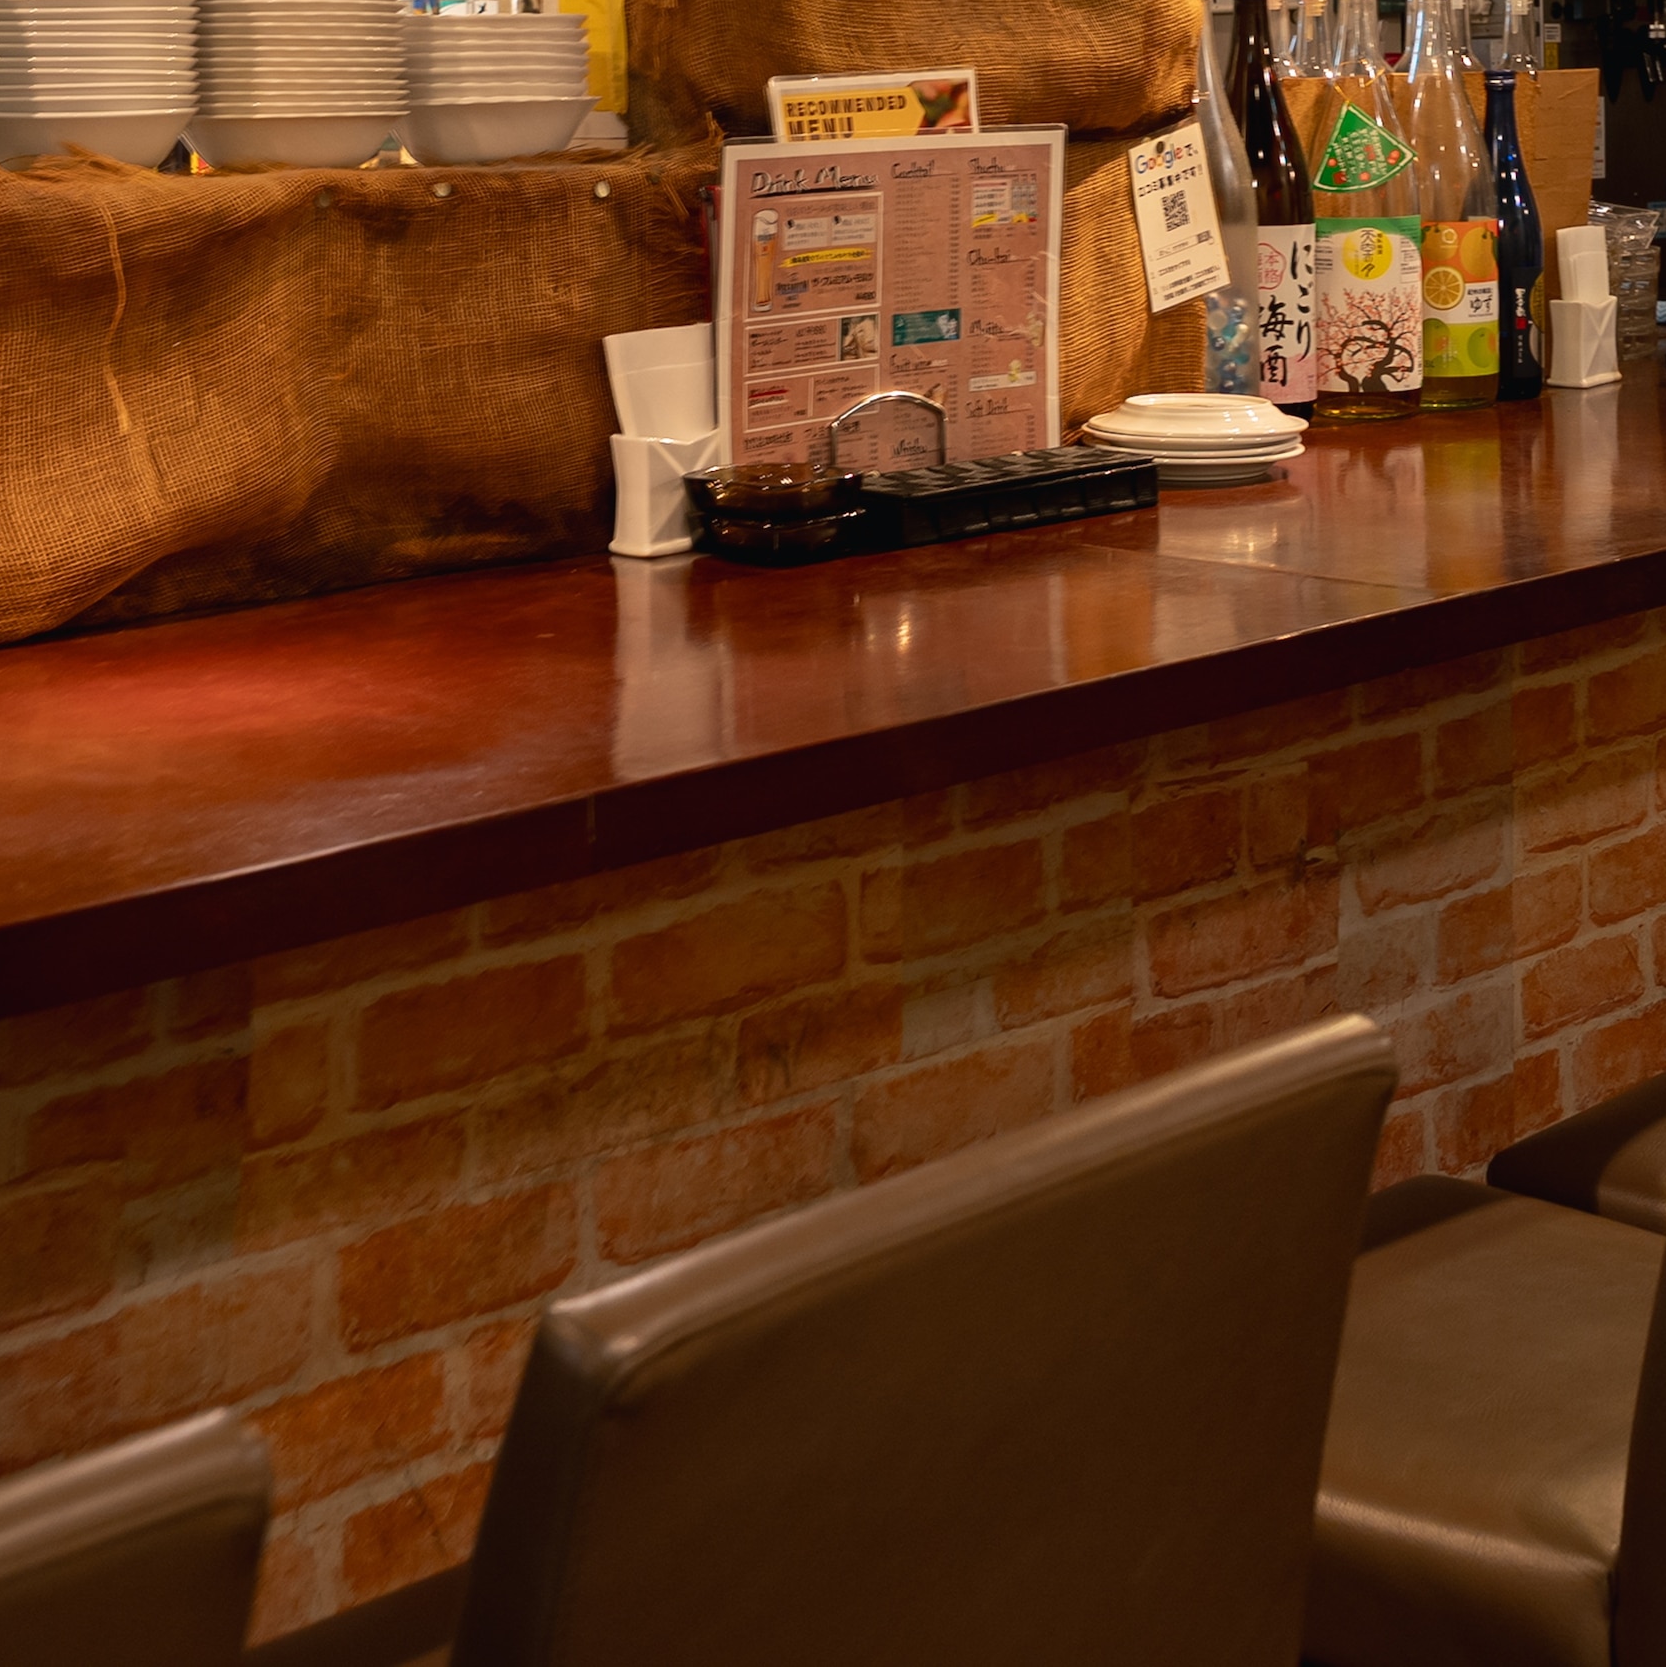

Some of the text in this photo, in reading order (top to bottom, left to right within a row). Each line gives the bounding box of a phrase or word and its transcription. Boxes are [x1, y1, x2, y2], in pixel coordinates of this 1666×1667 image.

[786, 95, 907, 117] RECOMMENDED
[787, 117, 854, 141] MENU
[751, 165, 879, 195] Drink Menu
[1290, 241, 1315, 363] にごり
